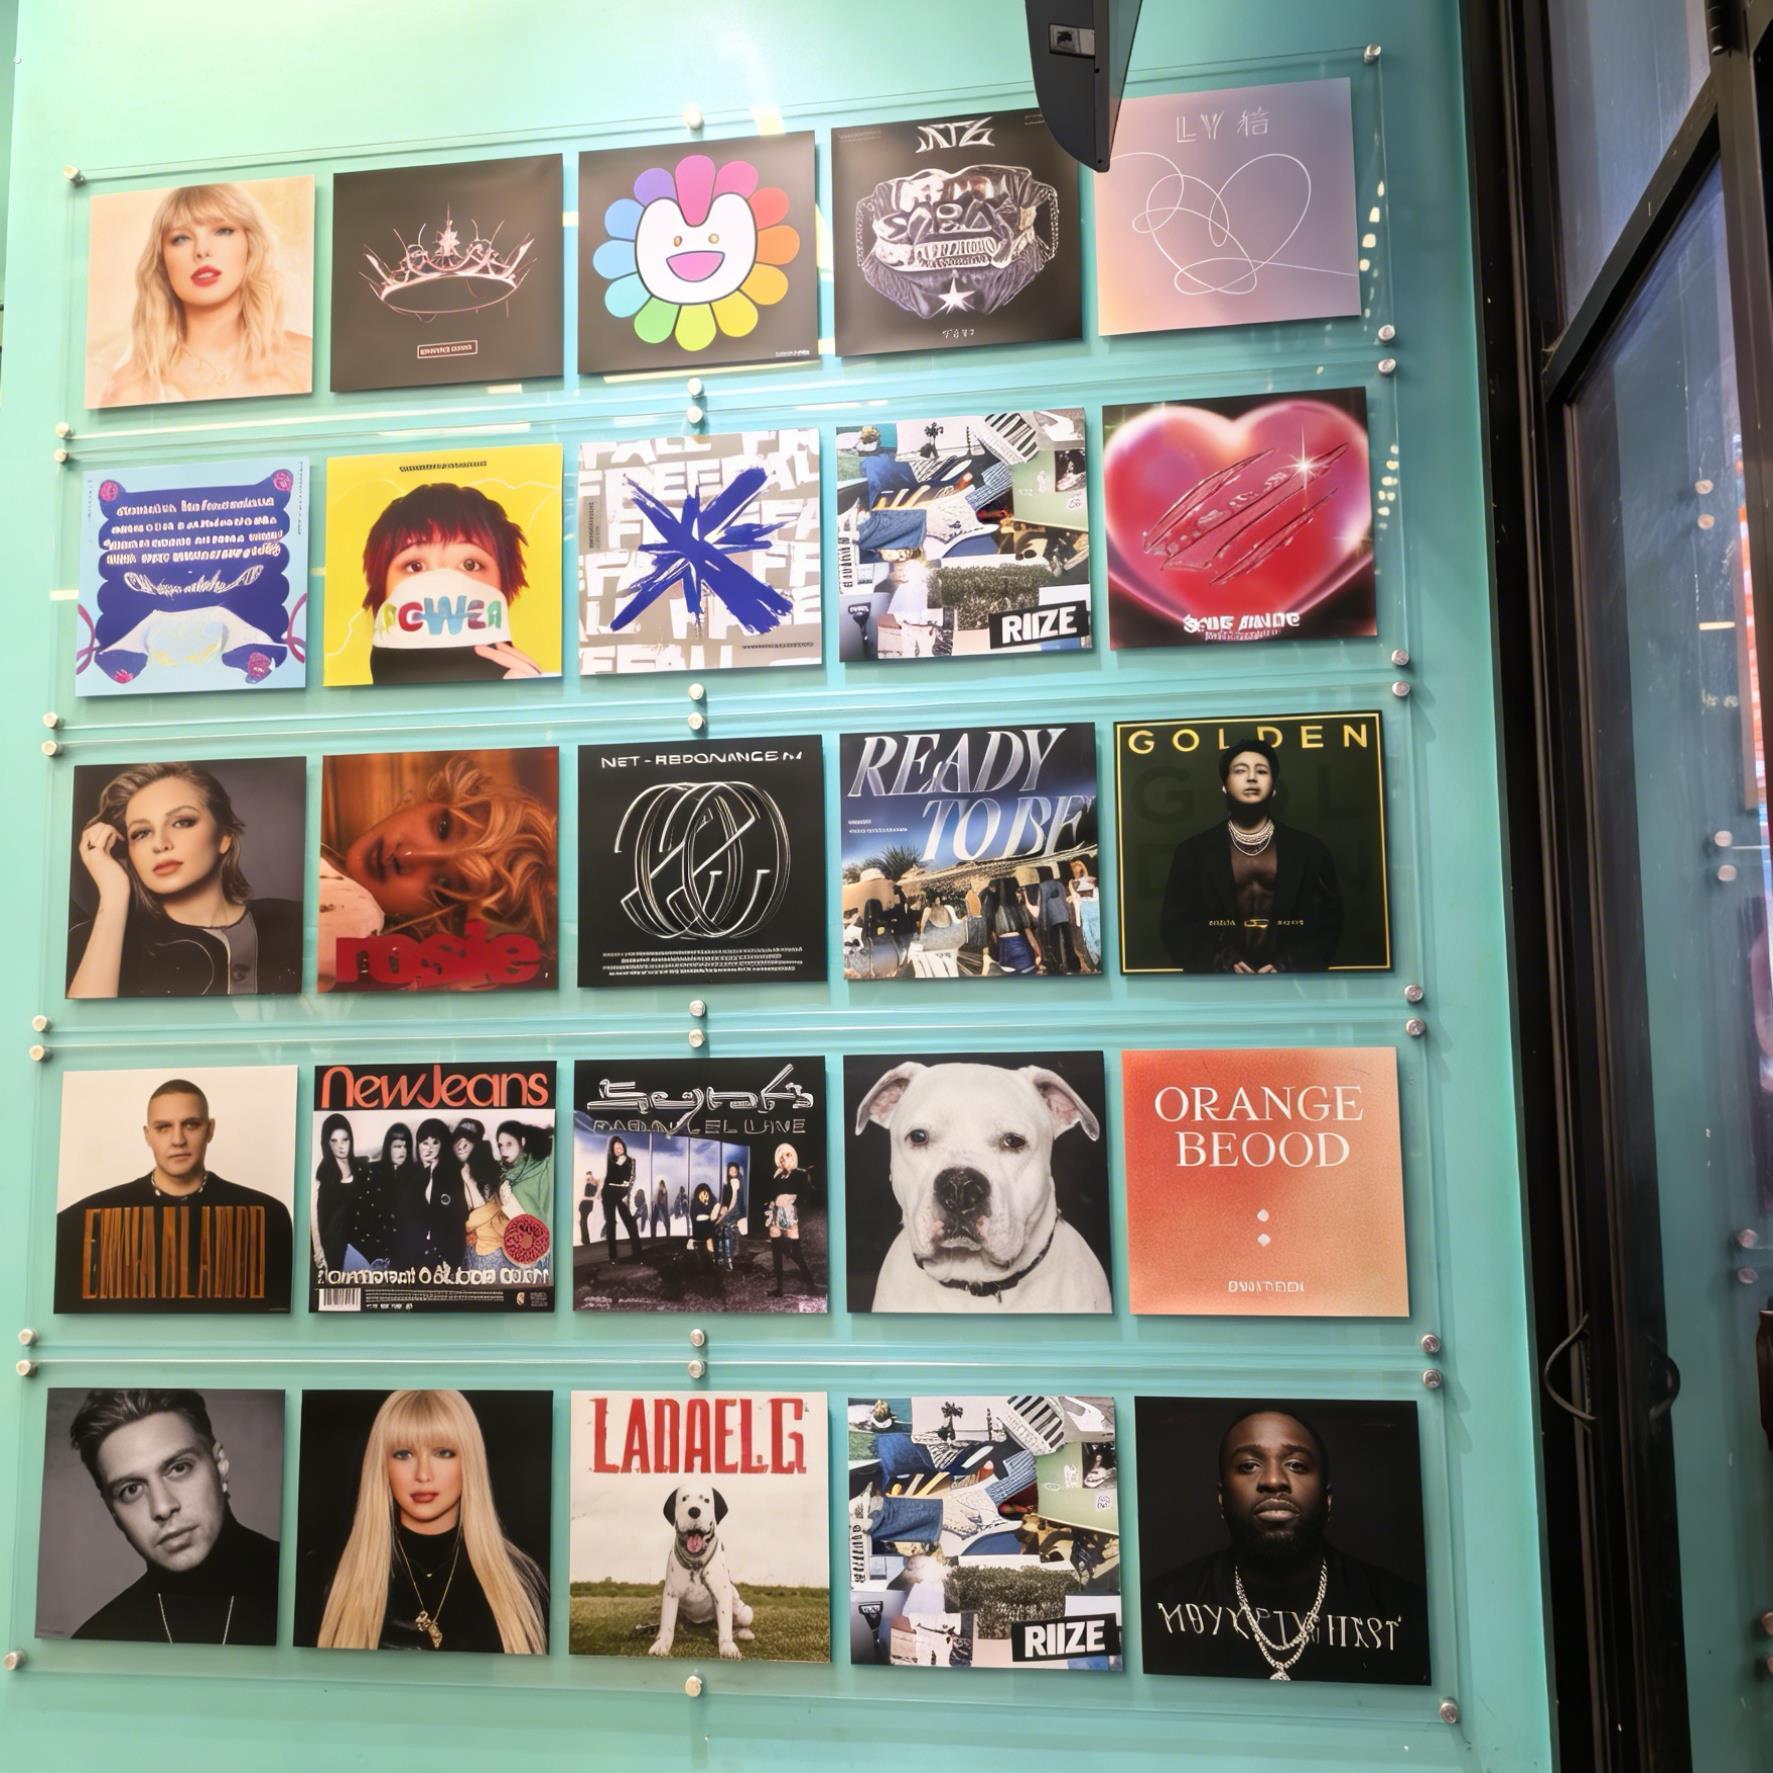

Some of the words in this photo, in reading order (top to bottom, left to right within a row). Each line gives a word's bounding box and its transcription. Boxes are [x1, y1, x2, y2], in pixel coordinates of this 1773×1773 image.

[1002, 605, 1077, 644] RIIZE
[1128, 724, 1368, 754] GOLDEN
[601, 756, 640, 769] NET
[848, 728, 1067, 797] READY
[921, 797, 1001, 861] TO
[1154, 1085, 1363, 1122] ORANGE
[1176, 1131, 1351, 1168] BEOOD
[1024, 1619, 1106, 1658] RIIZE
